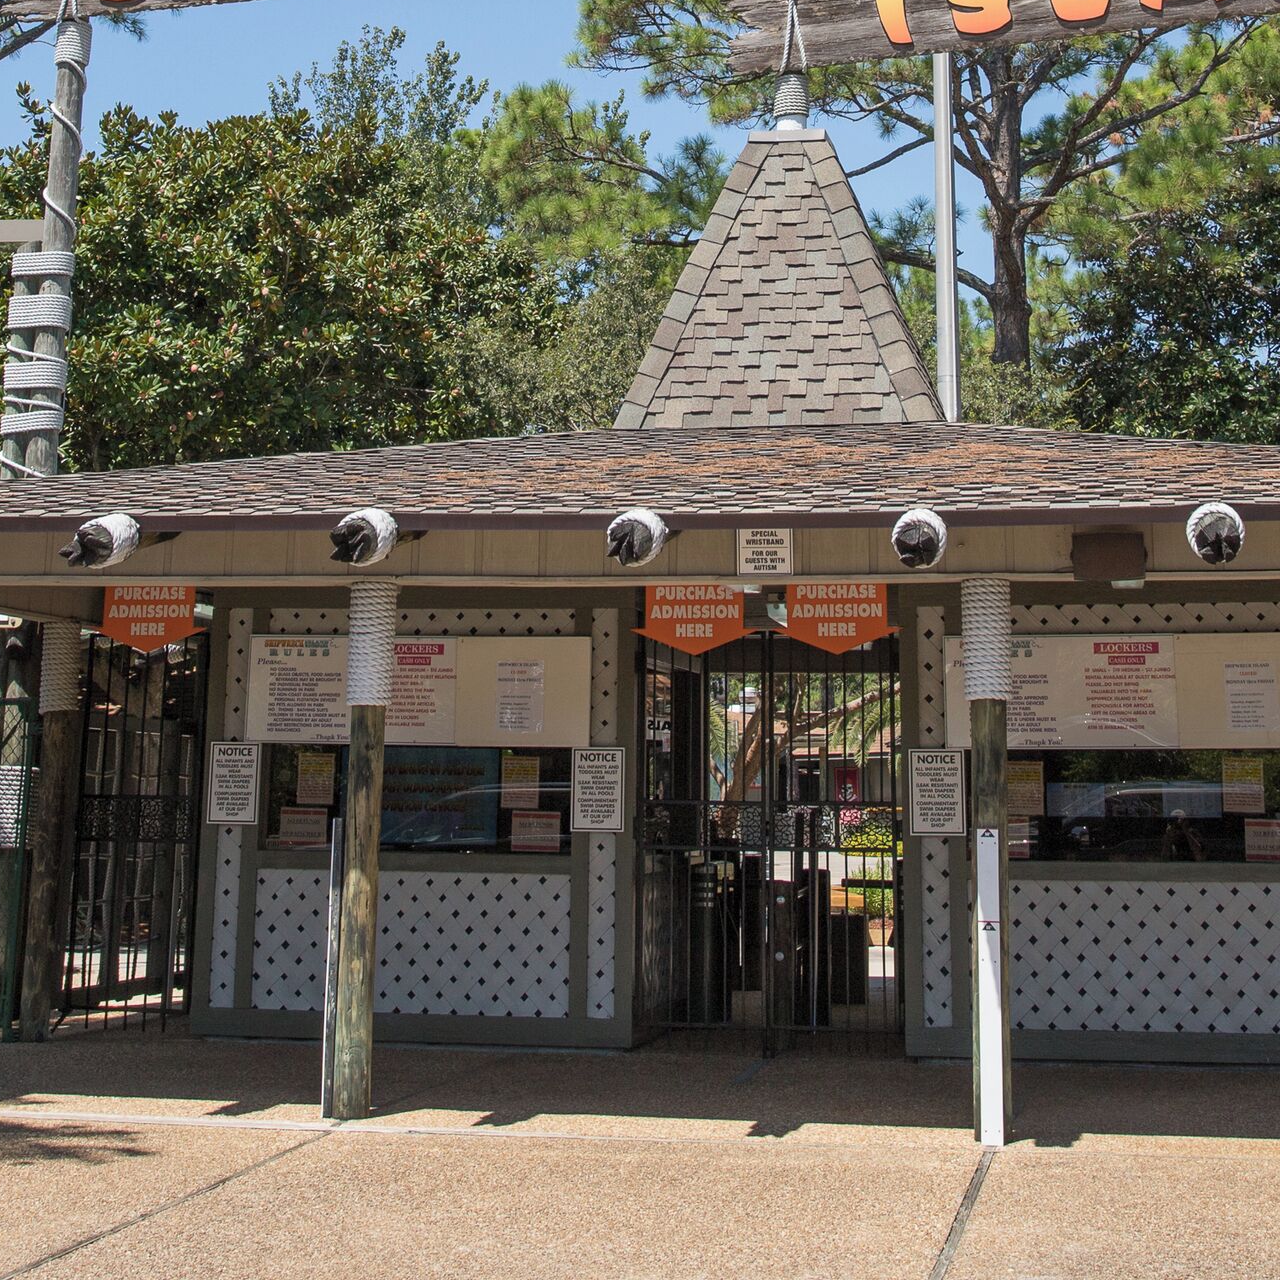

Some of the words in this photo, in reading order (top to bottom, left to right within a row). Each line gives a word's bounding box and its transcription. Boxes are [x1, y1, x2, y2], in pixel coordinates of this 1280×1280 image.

[115, 587, 185, 600] PURCHASE
[656, 586, 733, 600] PURCHASE
[797, 585, 876, 599] PURCHASE
[109, 605, 190, 617] ADMISSION
[651, 605, 738, 618] ADMISSION
[792, 603, 882, 617] ADMISSION
[131, 623, 165, 635] HERE
[676, 624, 713, 637] HERE
[818, 623, 856, 636] HERE
[219, 748, 252, 756] NOTICE
[580, 753, 616, 762] NOTICE
[917, 755, 955, 764] NOTICE
